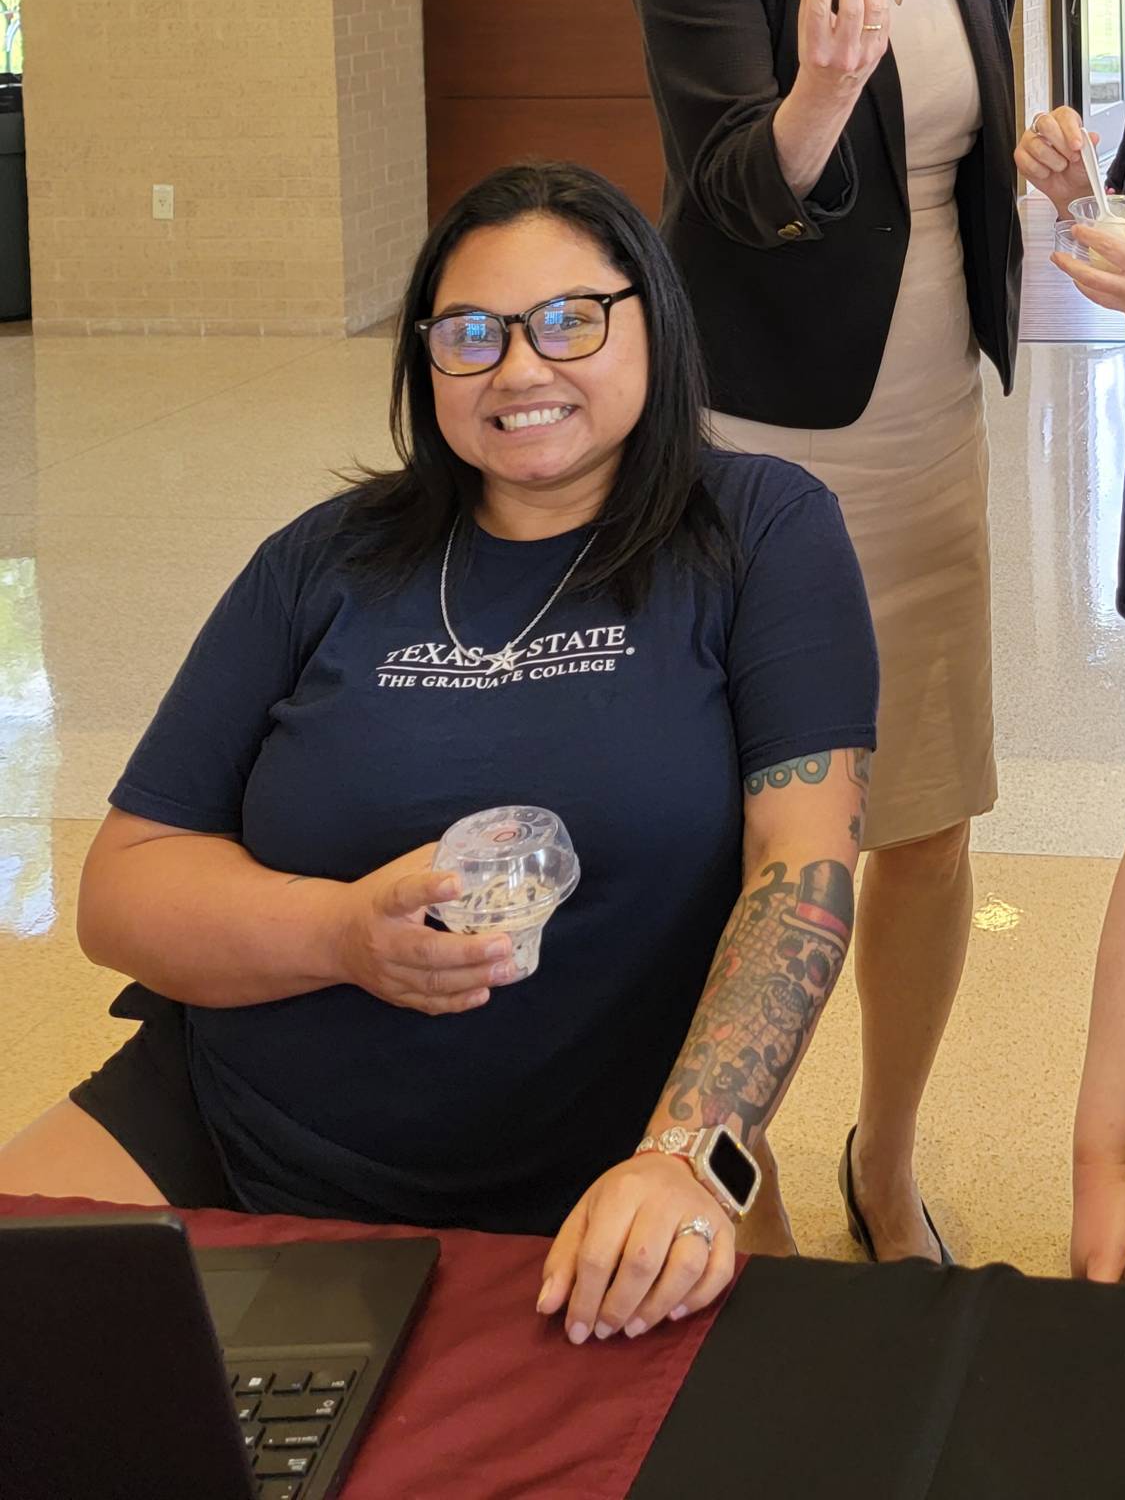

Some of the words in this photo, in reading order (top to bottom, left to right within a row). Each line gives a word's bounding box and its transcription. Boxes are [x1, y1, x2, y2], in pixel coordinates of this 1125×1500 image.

[384, 642, 484, 667] TEXAS
[526, 624, 626, 658] STATE
[376, 672, 416, 688] THE
[421, 669, 524, 690] GRADUATE
[529, 659, 616, 680] COLLEGE
